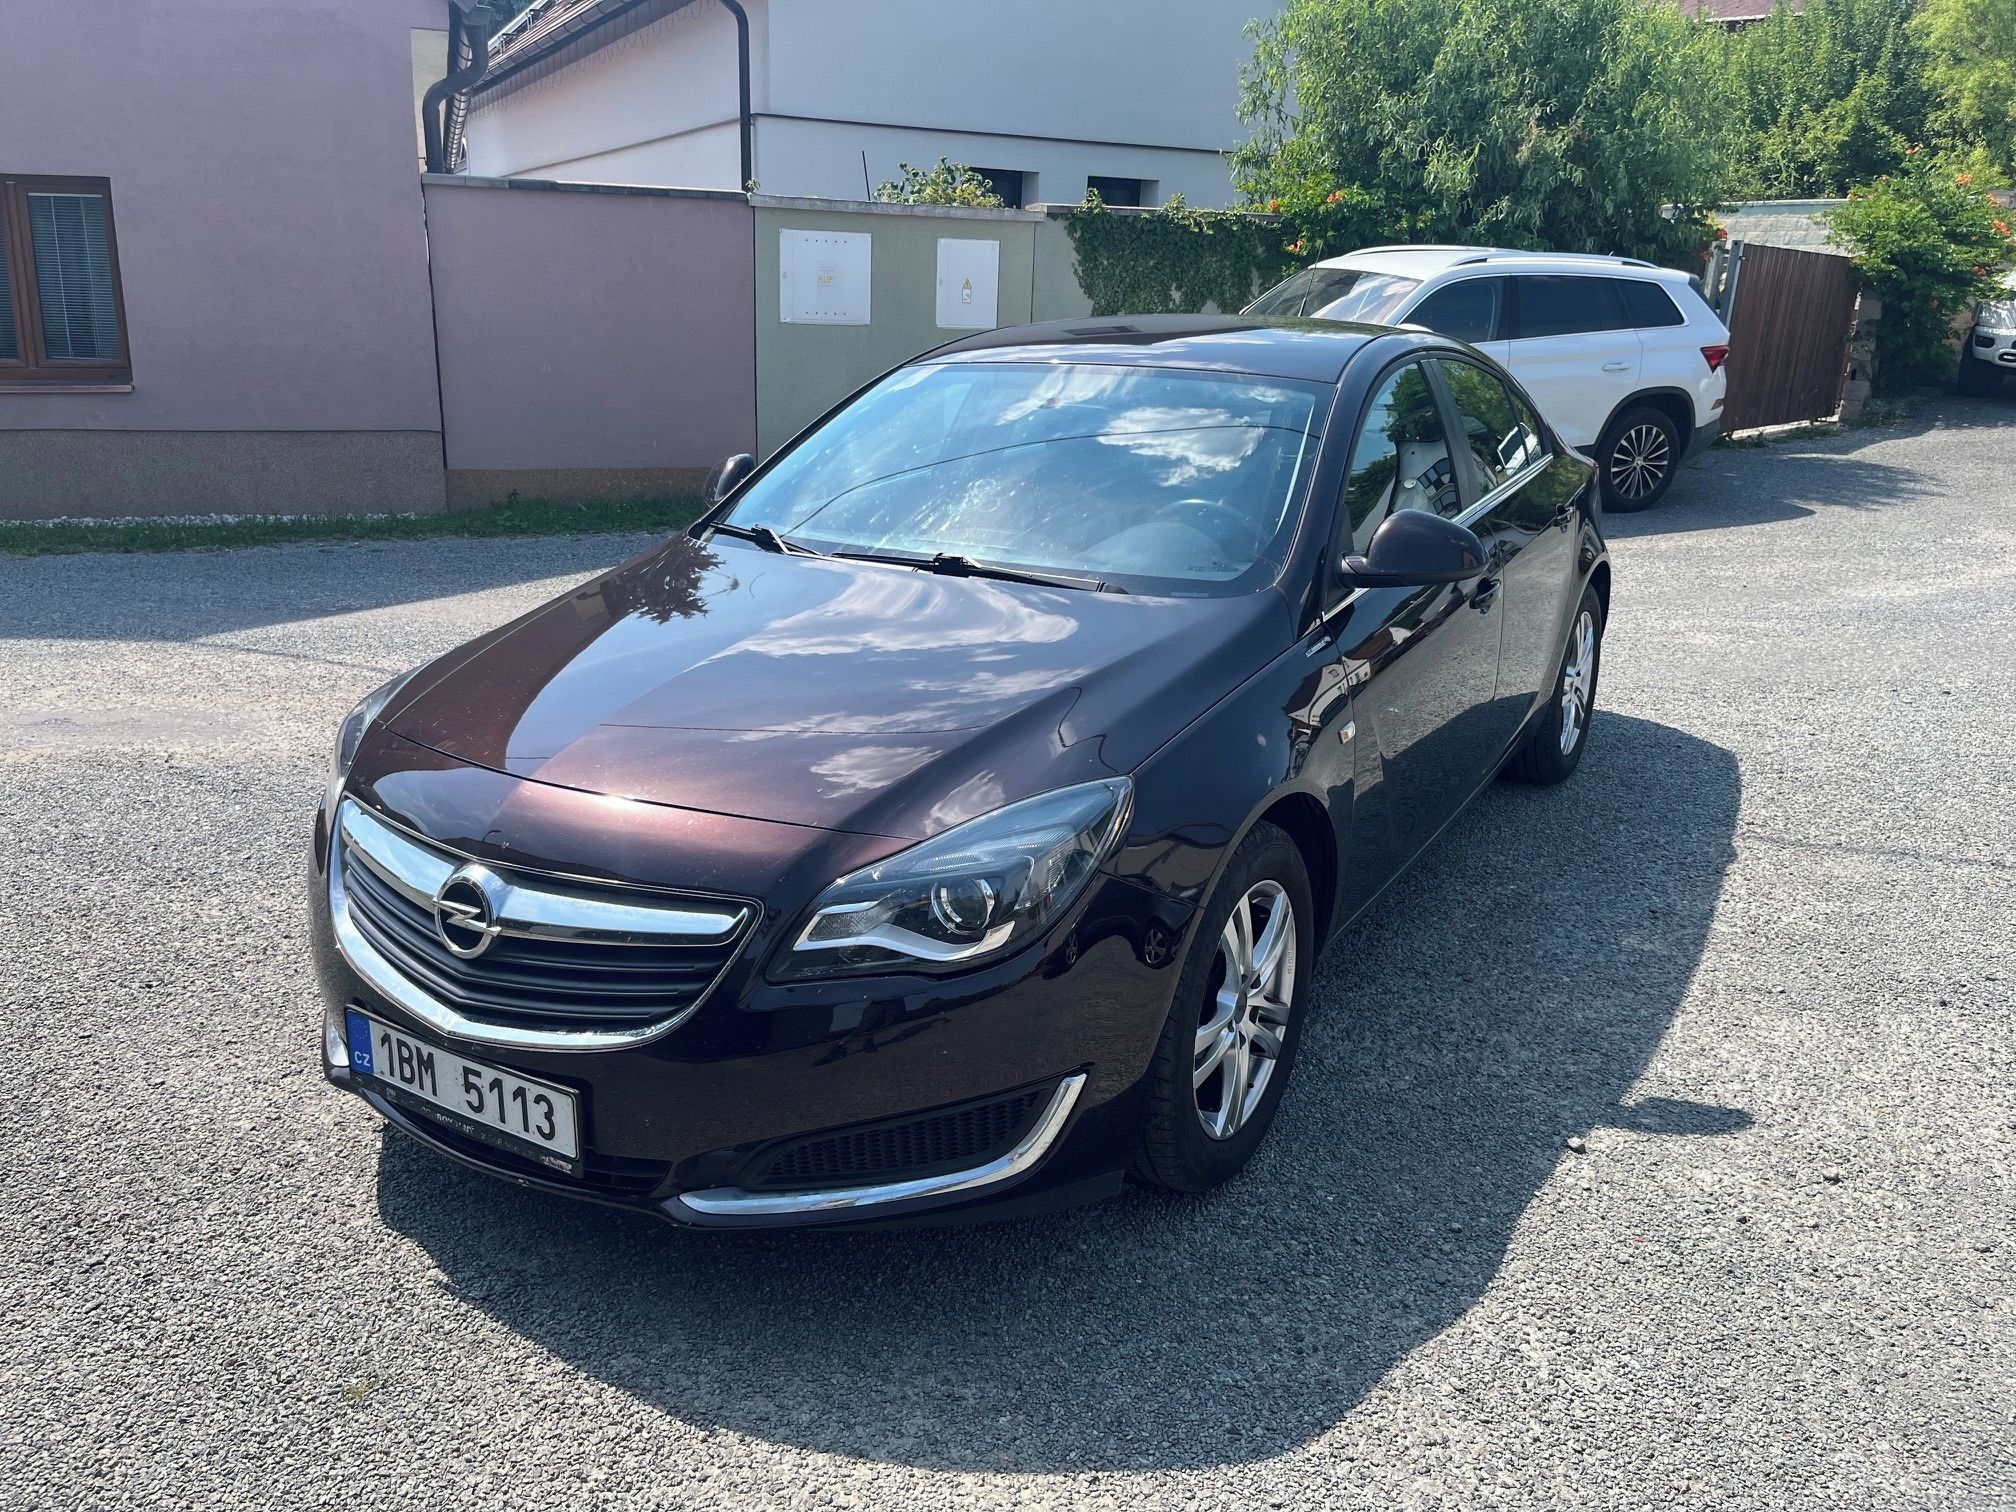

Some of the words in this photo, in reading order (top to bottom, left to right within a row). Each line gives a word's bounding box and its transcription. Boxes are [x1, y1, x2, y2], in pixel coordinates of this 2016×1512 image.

[354, 1050, 371, 1067] CZ
[381, 1032, 438, 1097] 1BM
[462, 1065, 556, 1141] 5113
